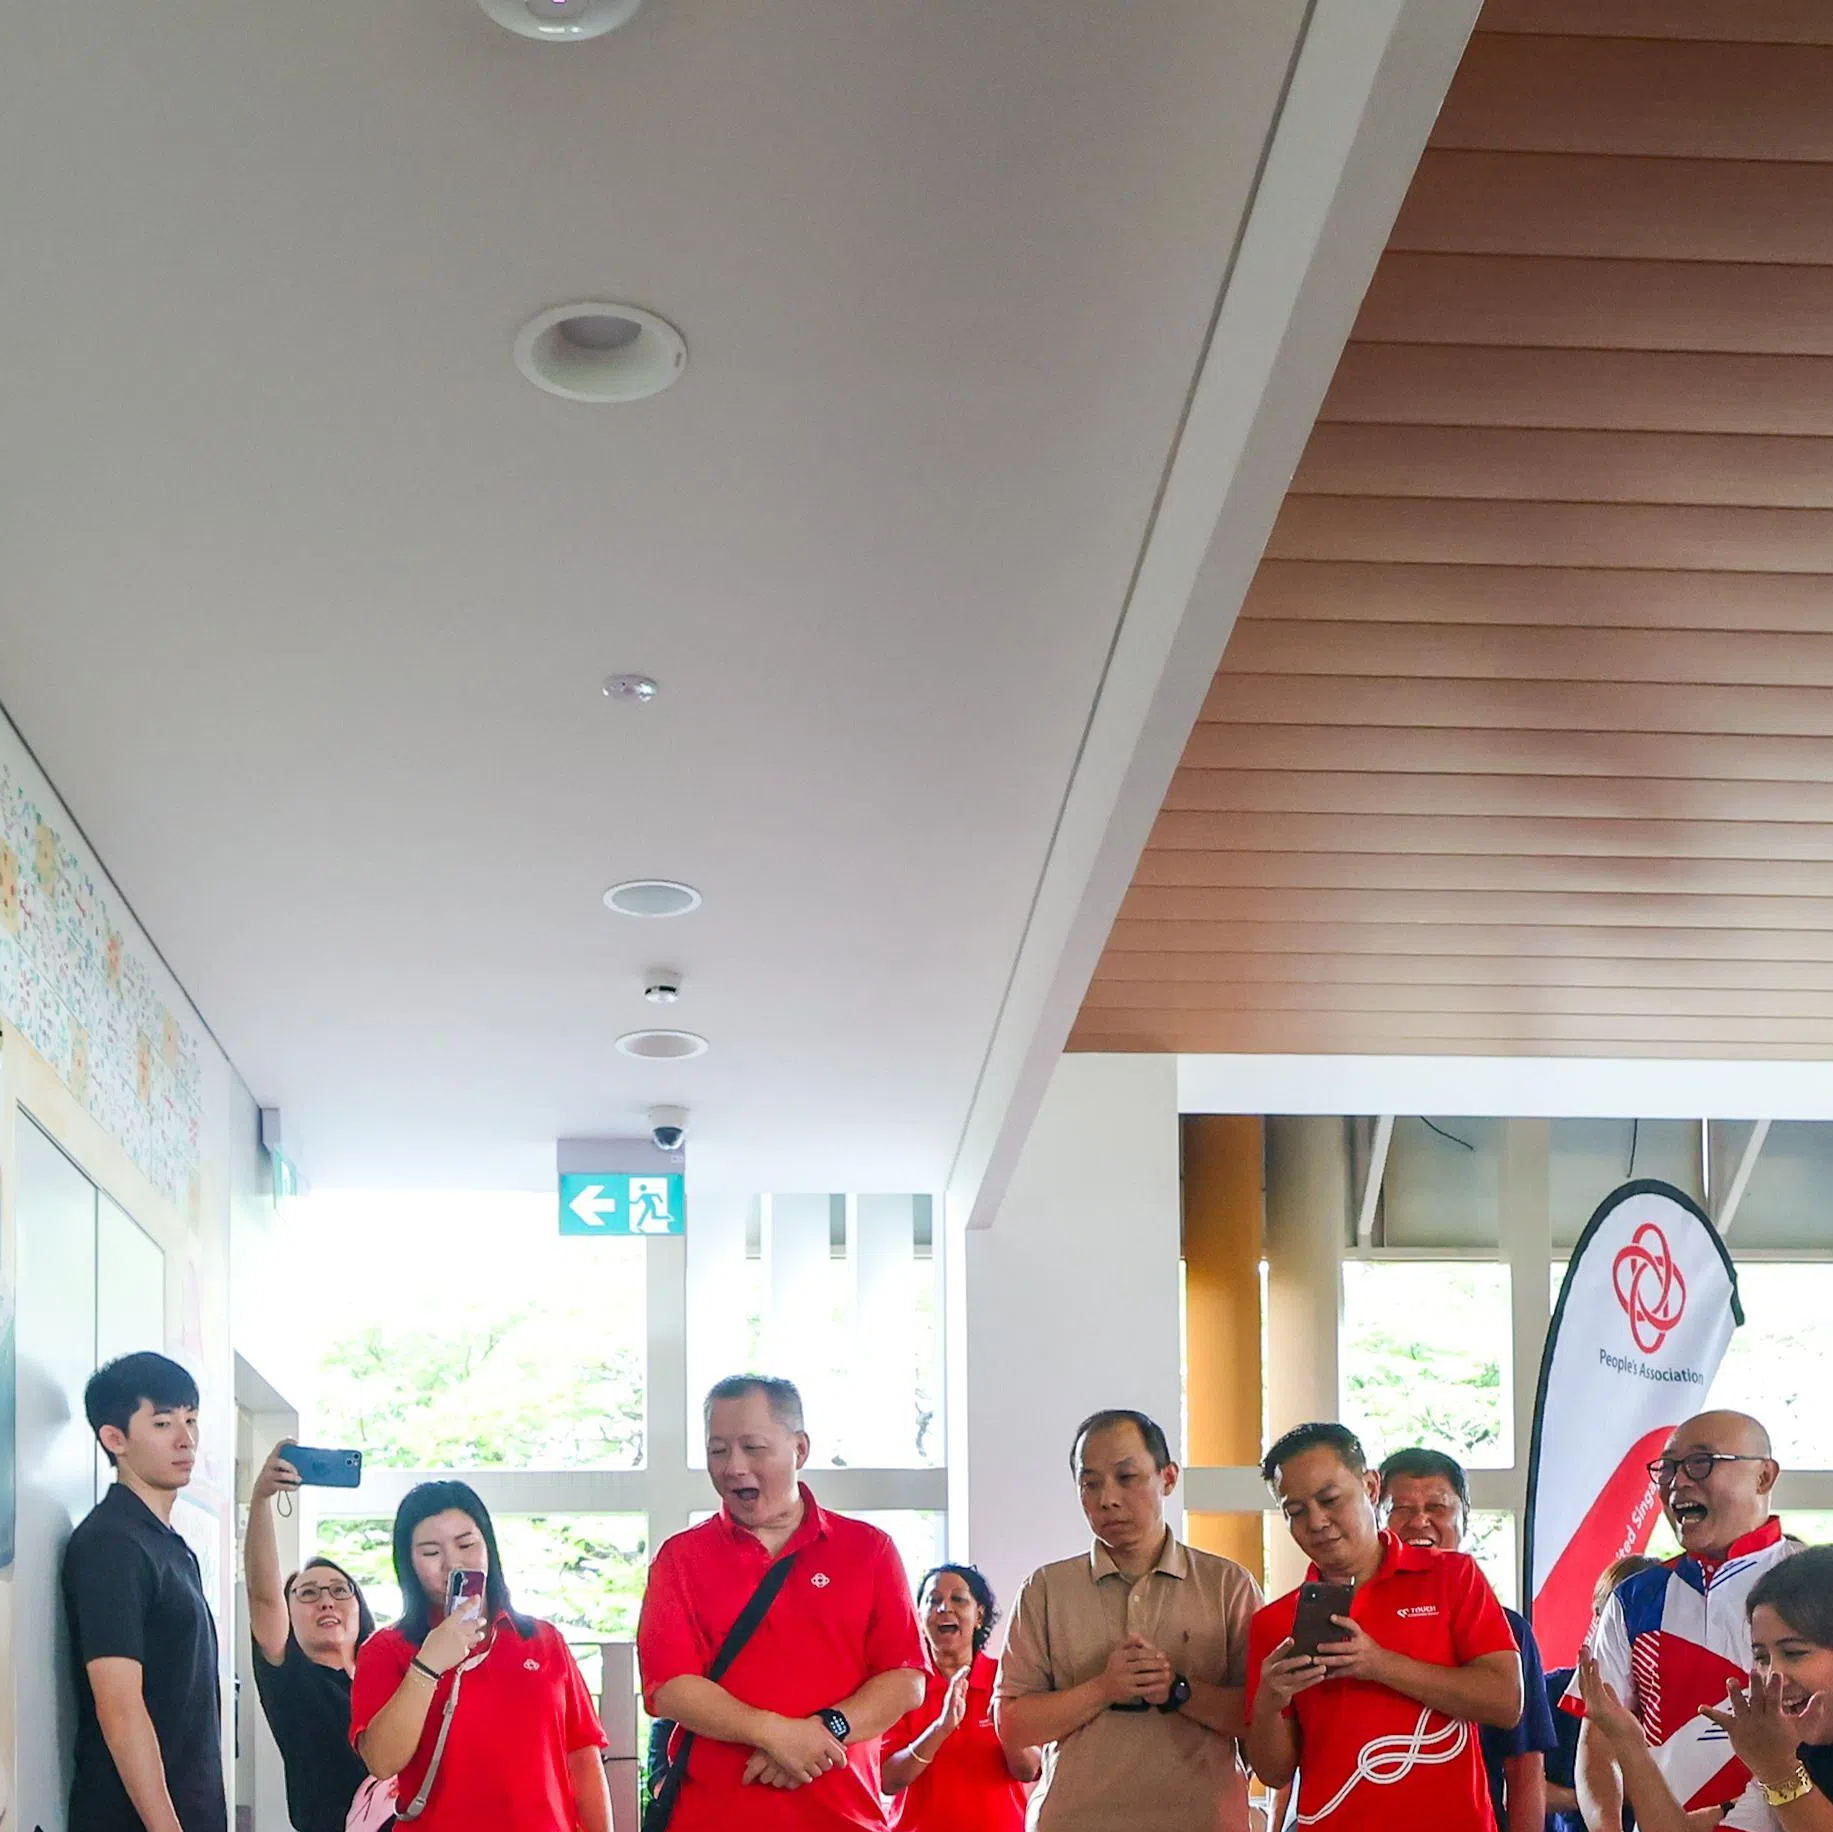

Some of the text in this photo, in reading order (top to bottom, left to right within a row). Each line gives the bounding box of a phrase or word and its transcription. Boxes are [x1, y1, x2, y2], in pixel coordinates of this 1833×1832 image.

[1599, 1348, 1704, 1385] People's Association
[1615, 1523, 1636, 1560] ited
